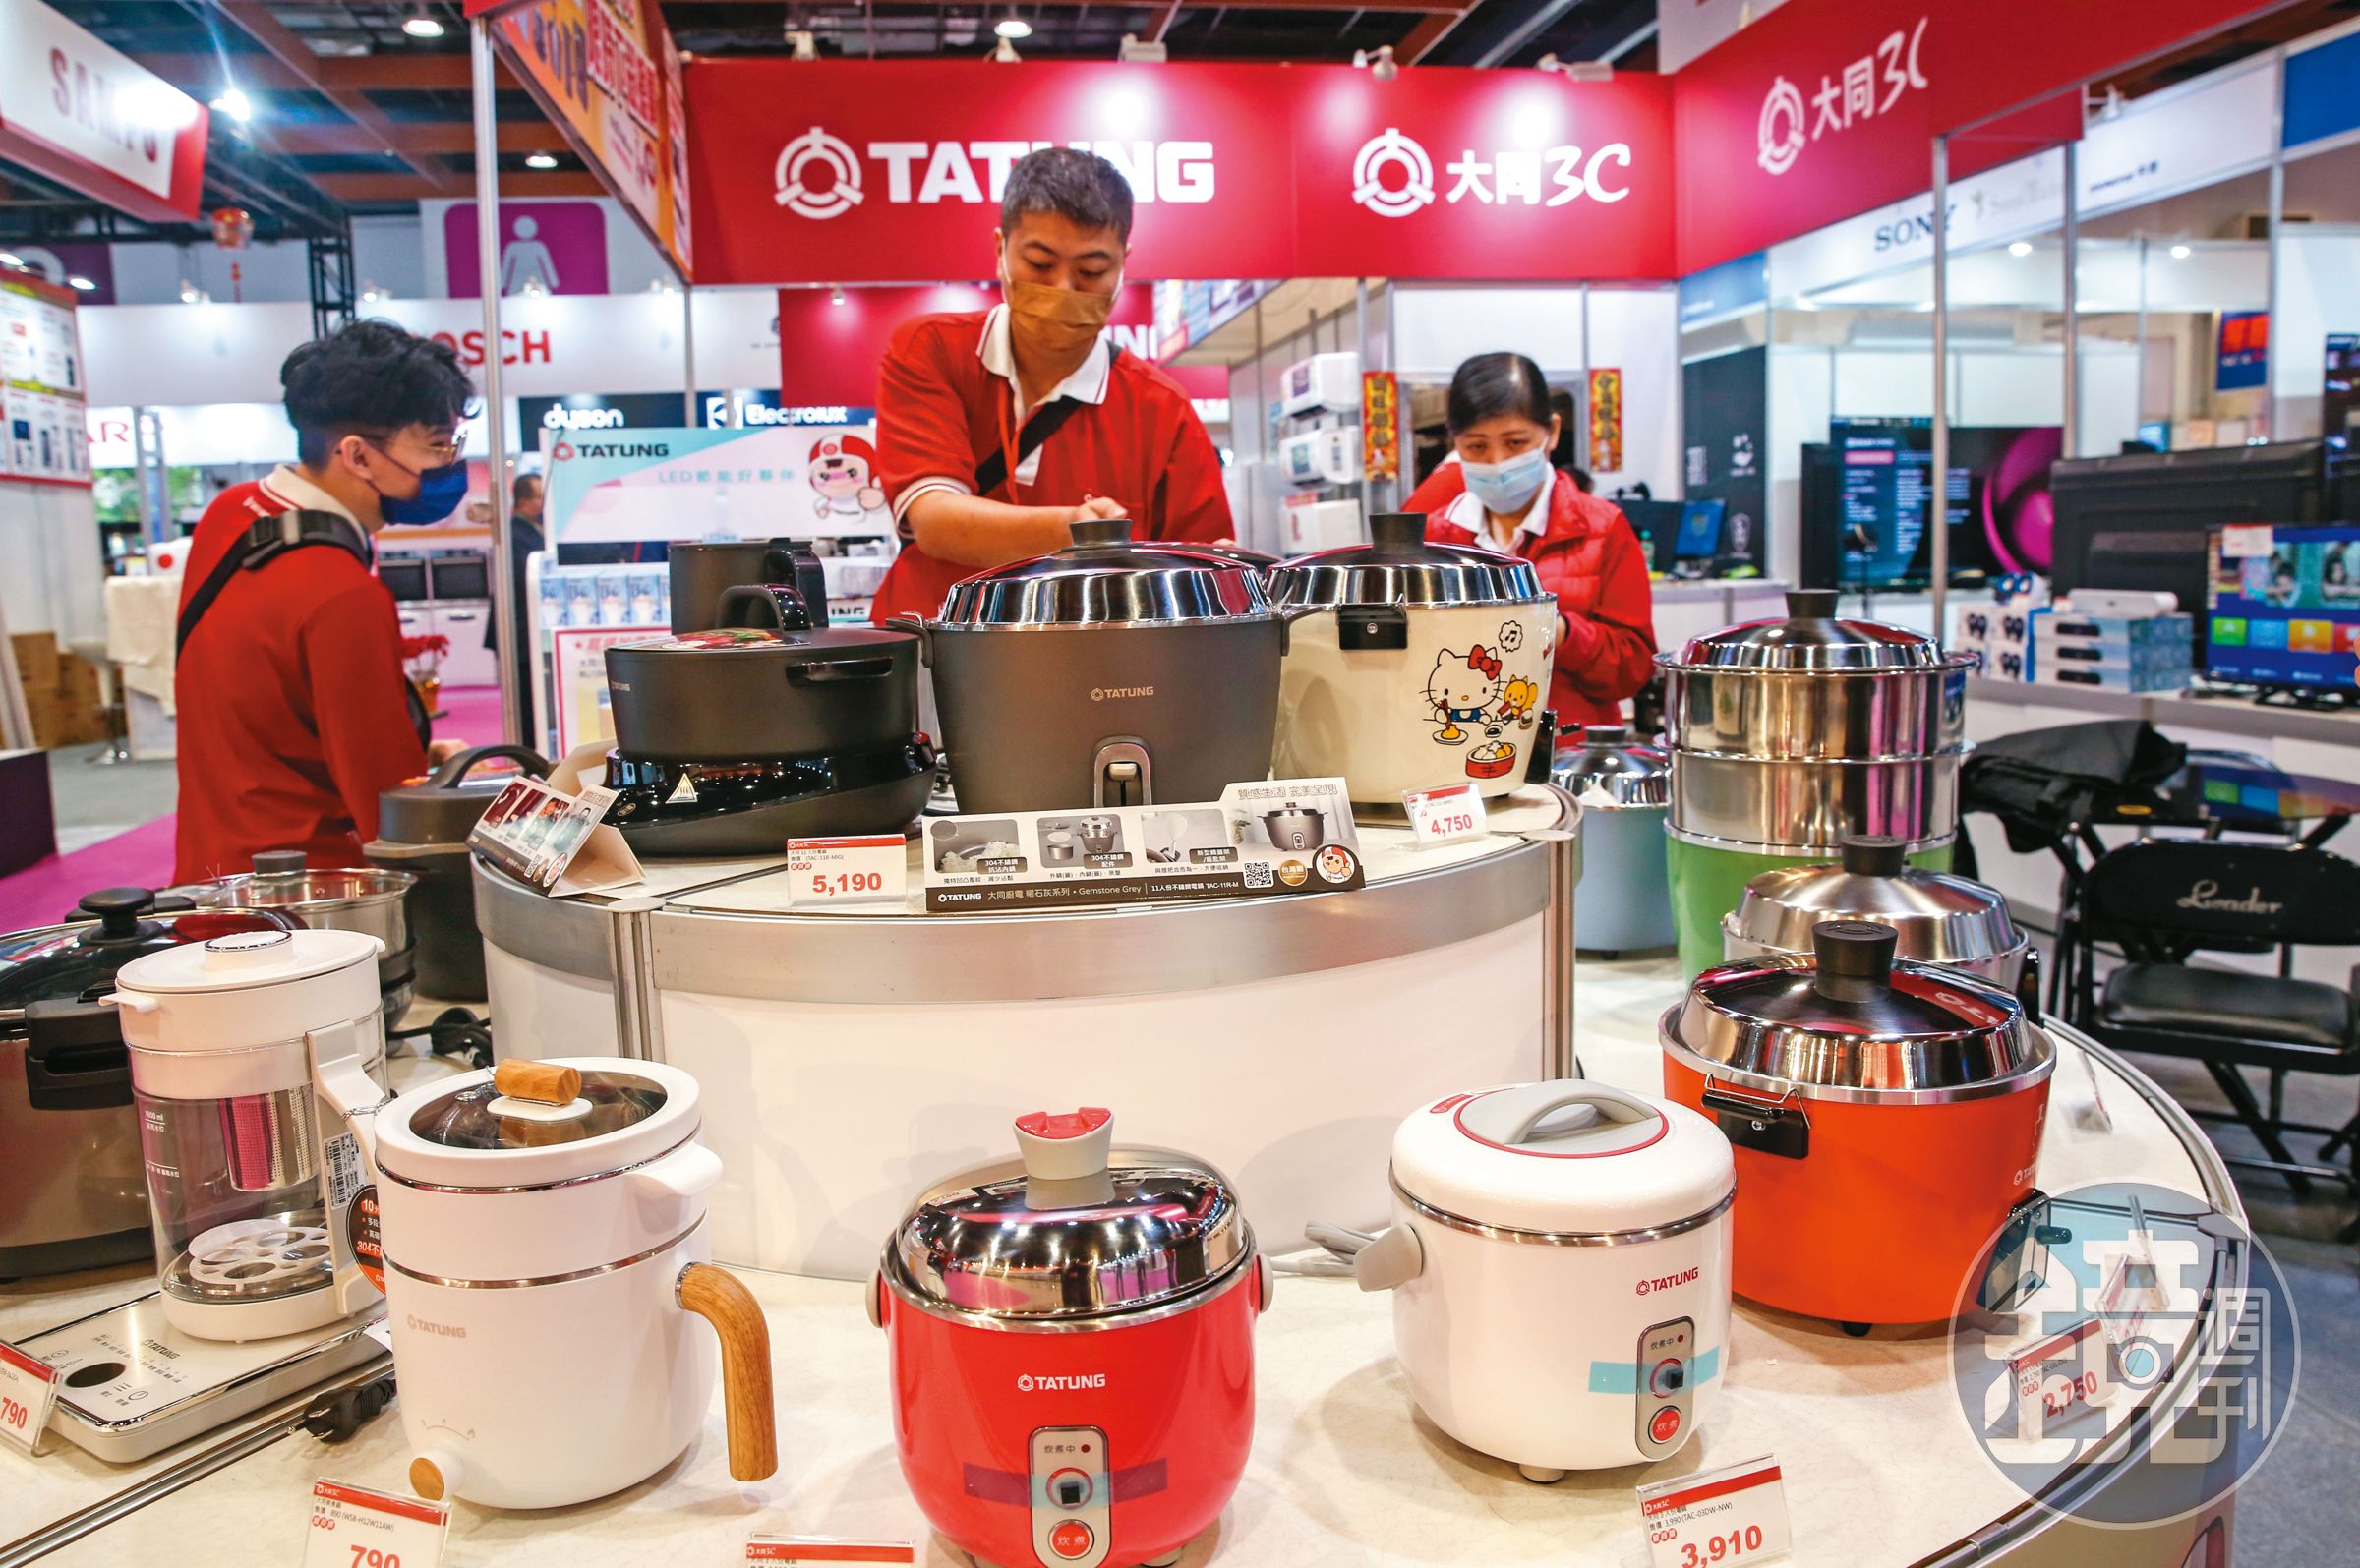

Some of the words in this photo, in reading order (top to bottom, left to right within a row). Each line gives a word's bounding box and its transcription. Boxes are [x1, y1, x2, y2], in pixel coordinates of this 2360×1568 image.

[867, 142, 1214, 203] TATNG
[543, 402, 624, 430] dyson
[578, 443, 669, 457] TATUNG
[1104, 686, 1154, 698] TATUNG
[1432, 814, 1472, 837] 4,750
[812, 873, 882, 896] 5,190
[1079, 886, 1121, 895] Gemstone
[1122, 885, 1142, 895] Grey
[1651, 1267, 1699, 1292] TATUNG
[417, 1319, 466, 1338] TATUNG
[148, 1343, 180, 1359] TATUNG
[1651, 1338, 1674, 1350] 炊煮中
[1034, 1373, 1106, 1390] TATUNG
[2043, 1371, 2097, 1417] 2,750
[1044, 1445, 1076, 1454] 炊煮中
[1665, 1516, 1682, 1528] 3,990
[1057, 1536, 1086, 1546] 炊煮
[1682, 1525, 1763, 1568] 3,910
